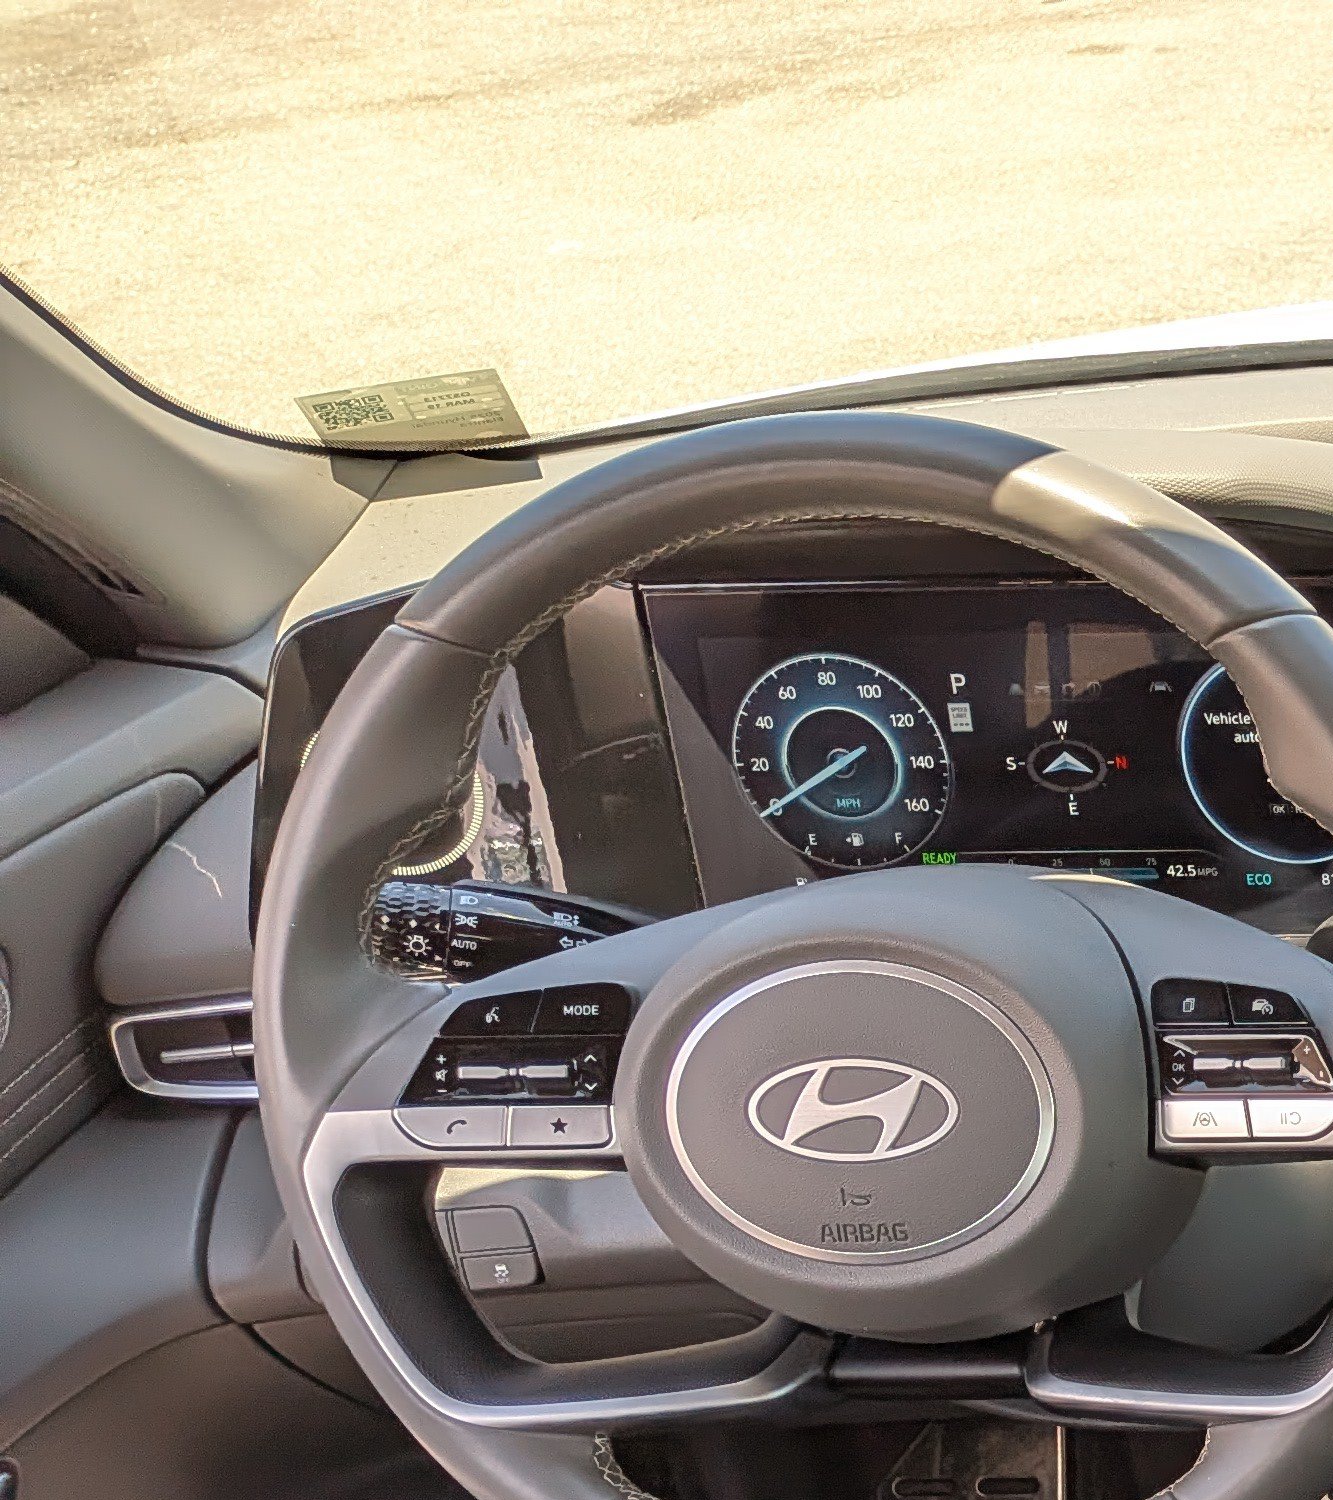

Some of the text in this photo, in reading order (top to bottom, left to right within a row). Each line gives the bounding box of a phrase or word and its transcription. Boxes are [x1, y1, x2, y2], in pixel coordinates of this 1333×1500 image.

[817, 671, 837, 686] 80
[949, 673, 966, 695] P
[778, 686, 797, 700] 60
[856, 684, 882, 699] 100
[755, 715, 774, 730] 40
[889, 713, 915, 728] 120
[1203, 712, 1251, 725] Vehicle
[1052, 719, 1068, 734] W
[751, 757, 770, 772] 20
[909, 755, 935, 770] 140
[1005, 756, 1017, 771] S
[1115, 755, 1128, 770] N
[836, 798, 861, 808] MPH
[904, 798, 930, 813] 160
[1068, 801, 1080, 816] E
[1272, 804, 1286, 814] OK
[808, 833, 818, 846] E
[894, 832, 903, 844] F
[922, 852, 957, 865] READY
[1052, 858, 1063, 867] 25
[1166, 864, 1219, 878] 42.5 MPG
[1245, 873, 1273, 886] ECO
[451, 938, 478, 951] AUTO
[563, 1004, 600, 1017] MODE
[1171, 1061, 1186, 1073] OK
[820, 1222, 909, 1243] AIRBAG
